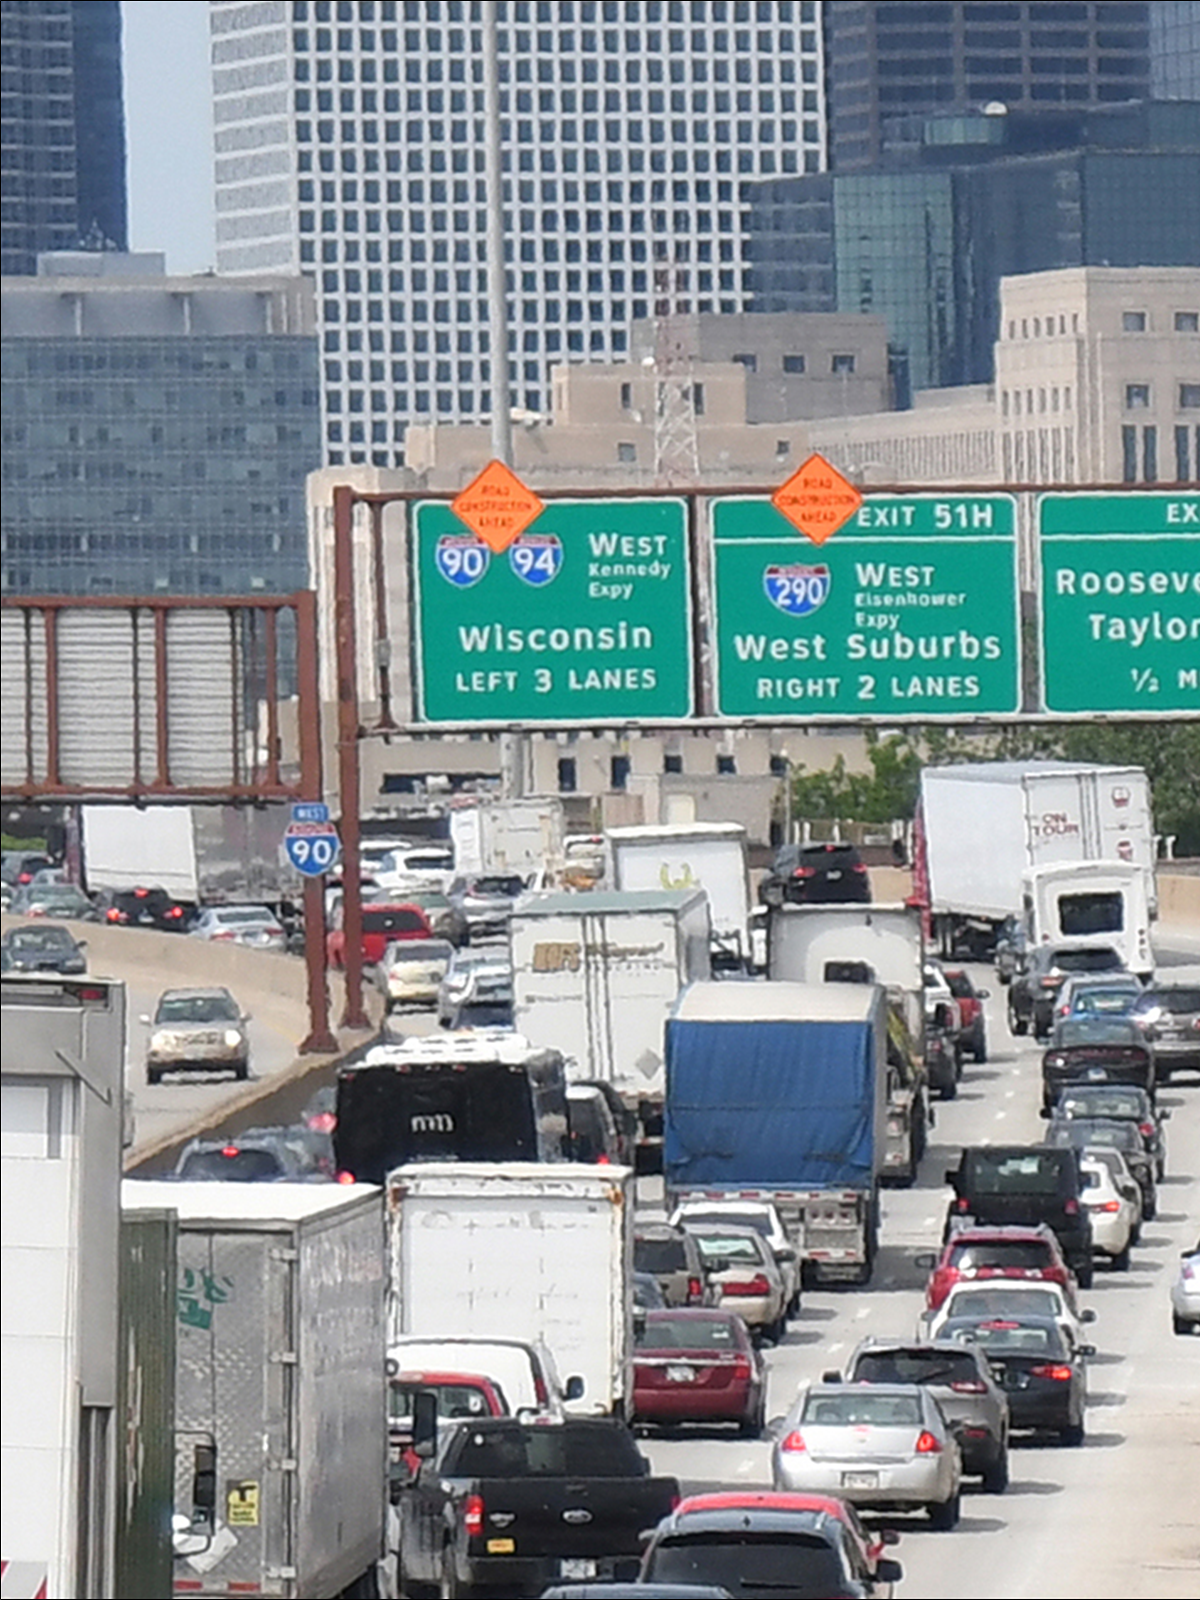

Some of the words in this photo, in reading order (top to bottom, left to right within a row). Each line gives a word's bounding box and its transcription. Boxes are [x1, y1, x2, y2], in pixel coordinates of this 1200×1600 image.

[856, 504, 915, 527] EXIT
[935, 504, 992, 528] 51H
[589, 533, 666, 556] WEST
[442, 547, 483, 576] 90
[514, 546, 556, 575] 94
[589, 561, 670, 578] Kennedy
[856, 563, 934, 587] WEST
[589, 582, 632, 599] Expy
[776, 577, 823, 605] 290
[855, 593, 965, 606] Eisenhower
[856, 613, 899, 630] Expy
[460, 622, 651, 651] Wisconsin
[735, 635, 826, 660] West
[848, 630, 1000, 659] Suburbs
[457, 672, 517, 691] LEFT
[535, 669, 551, 692] 3
[569, 669, 656, 689] LANES
[758, 678, 839, 698] RIGHT
[858, 675, 875, 699] 2
[892, 676, 979, 697] LANES
[1041, 812, 1068, 824] ON
[293, 839, 332, 865] 90
